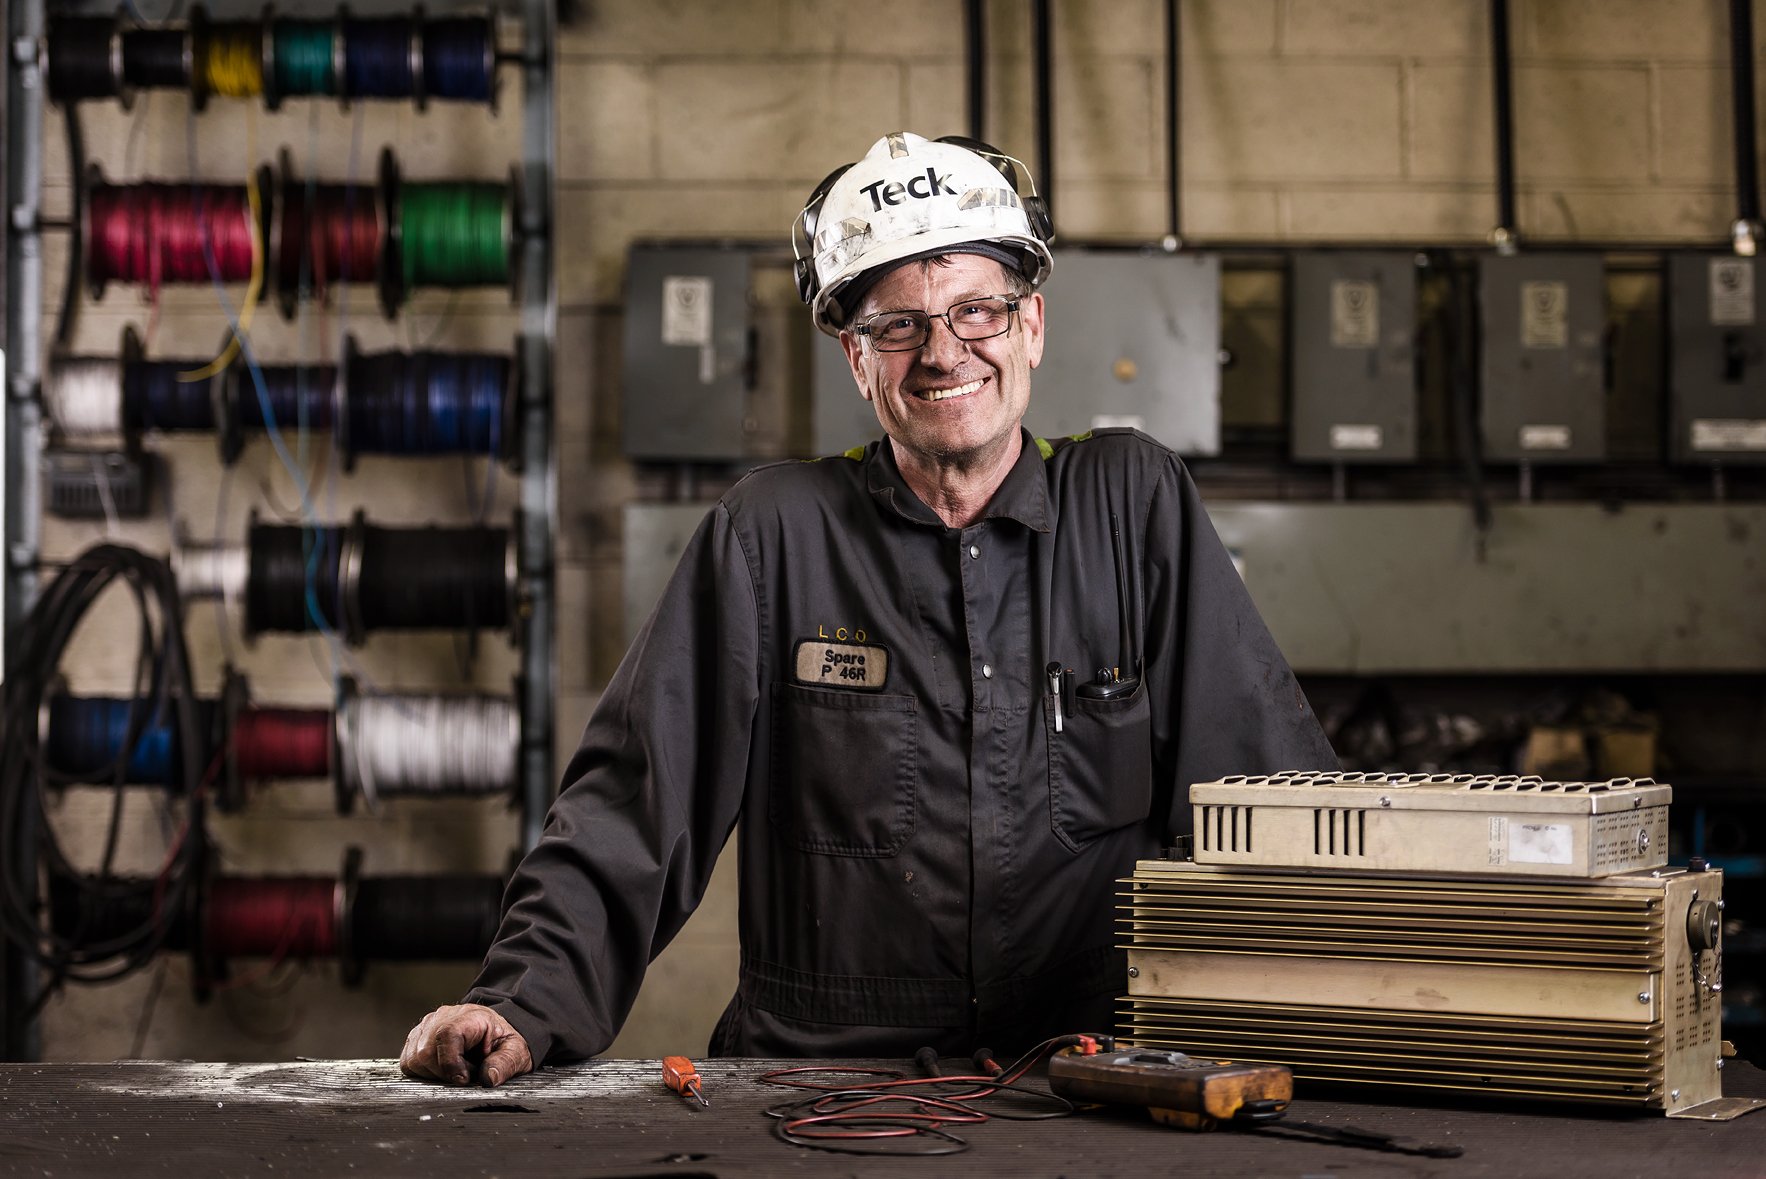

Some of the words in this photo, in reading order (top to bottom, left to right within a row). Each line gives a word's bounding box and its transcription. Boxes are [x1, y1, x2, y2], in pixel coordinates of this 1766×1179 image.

[860, 167, 957, 212] Teck
[825, 649, 865, 666] Spare
[821, 664, 832, 677] P
[839, 665, 866, 681] 46R
